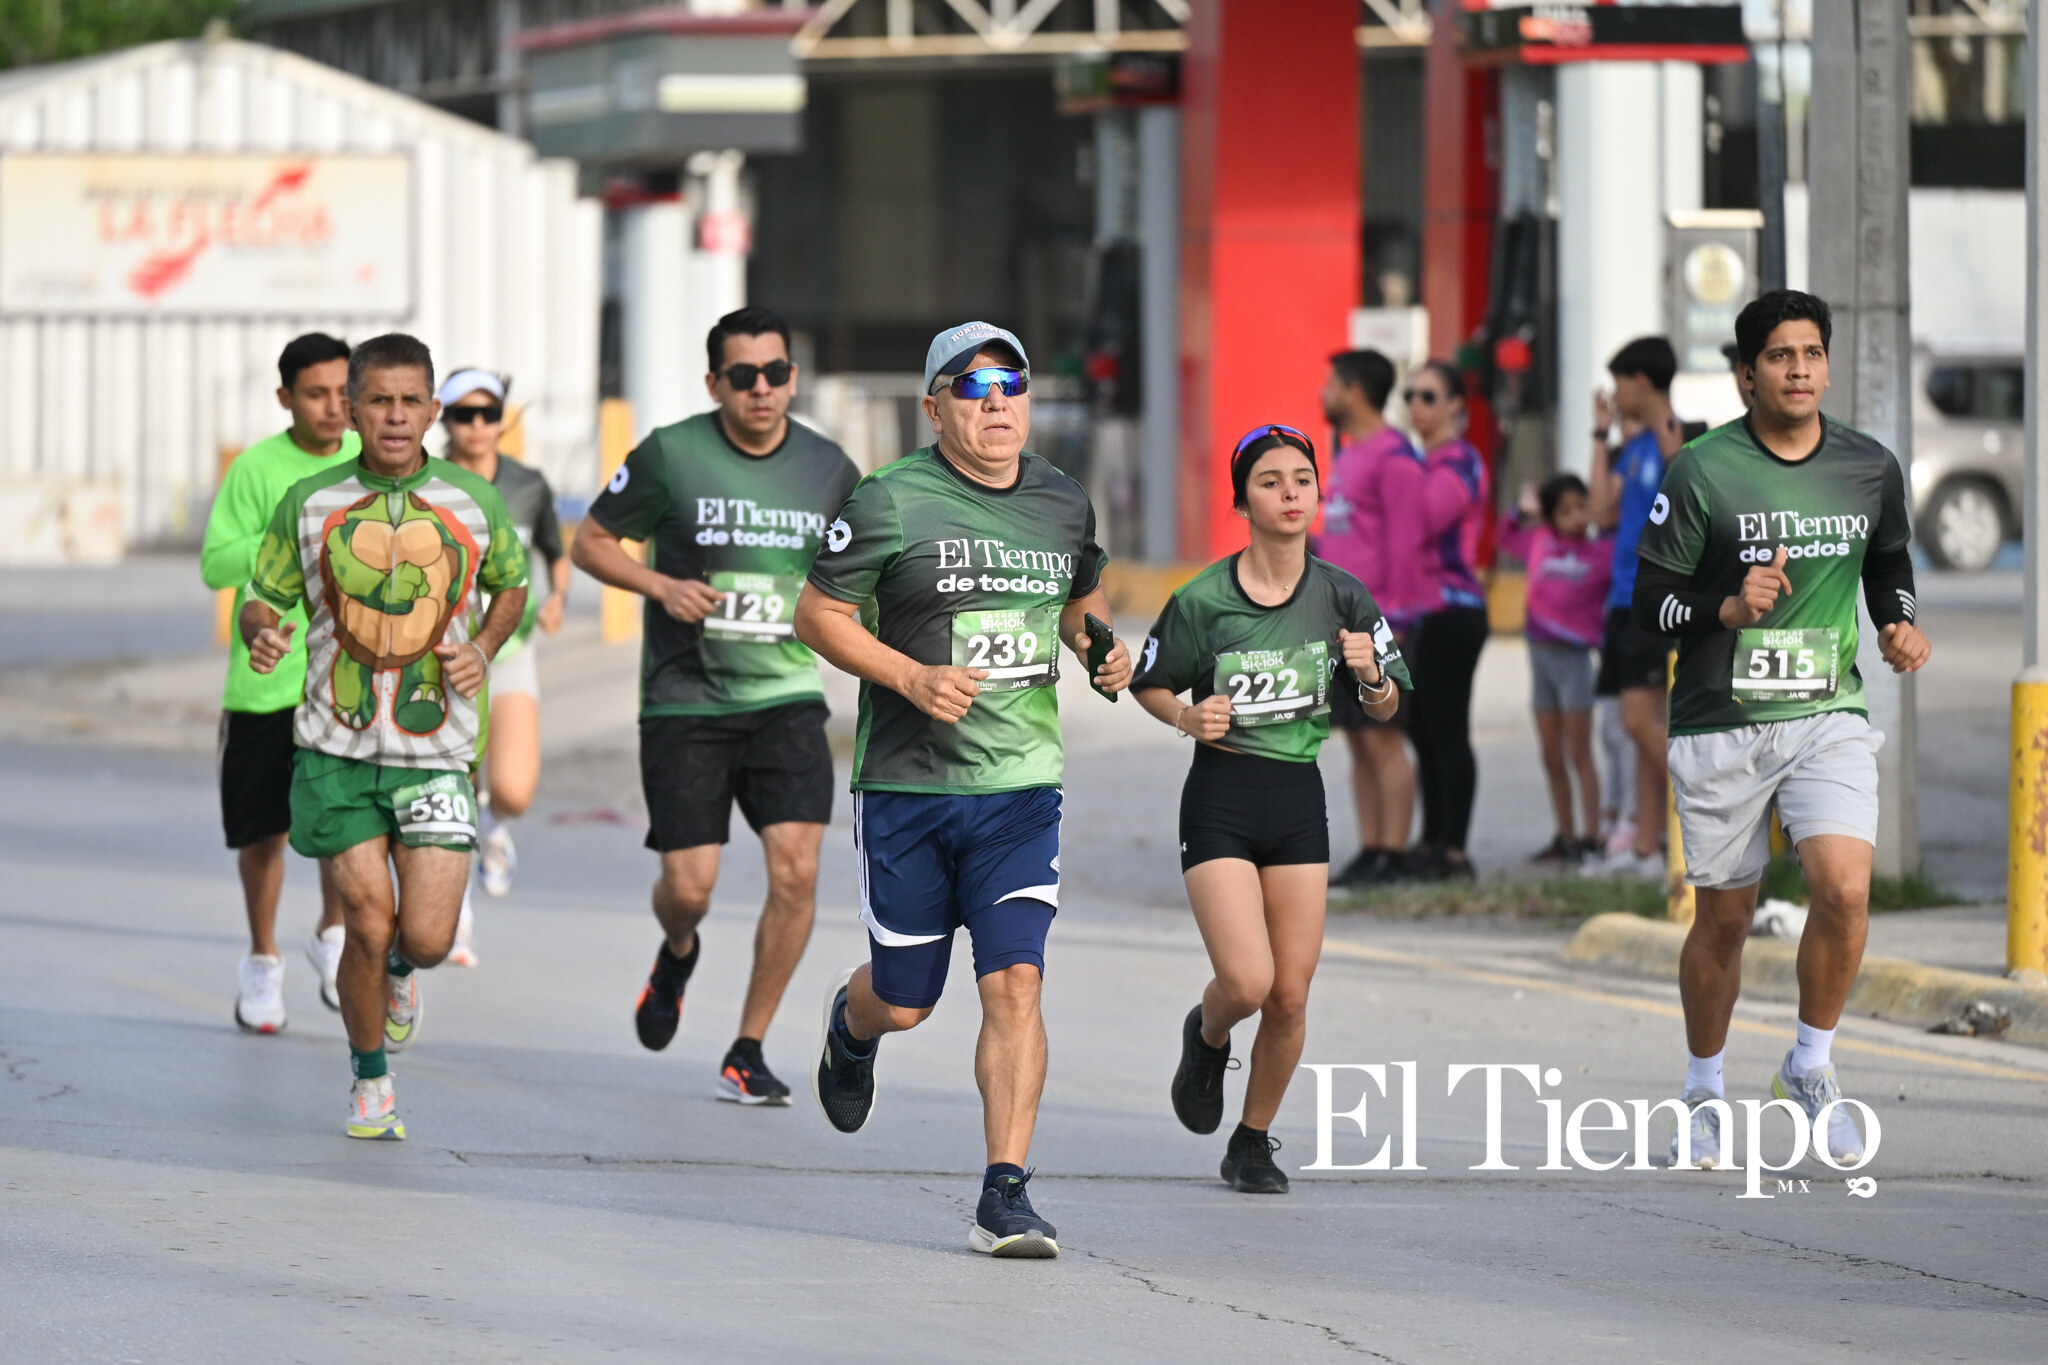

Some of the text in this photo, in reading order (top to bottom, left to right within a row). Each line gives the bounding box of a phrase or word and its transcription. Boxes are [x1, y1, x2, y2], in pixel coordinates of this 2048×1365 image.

[696, 498, 826, 535] El Tiempo
[1736, 511, 1868, 541] El Tiempo
[696, 528, 805, 549] de todos
[935, 538, 1071, 578] El Tiempo
[1740, 546, 1772, 563] de
[936, 573, 1059, 595] de todos
[725, 591, 785, 622] 129
[967, 631, 1038, 667] 239
[1749, 649, 1815, 679] 515
[1316, 658, 1325, 705] MEDALLA
[1829, 643, 1837, 692] MEDALLA
[1228, 668, 1299, 704] 222
[410, 792, 470, 823] 530
